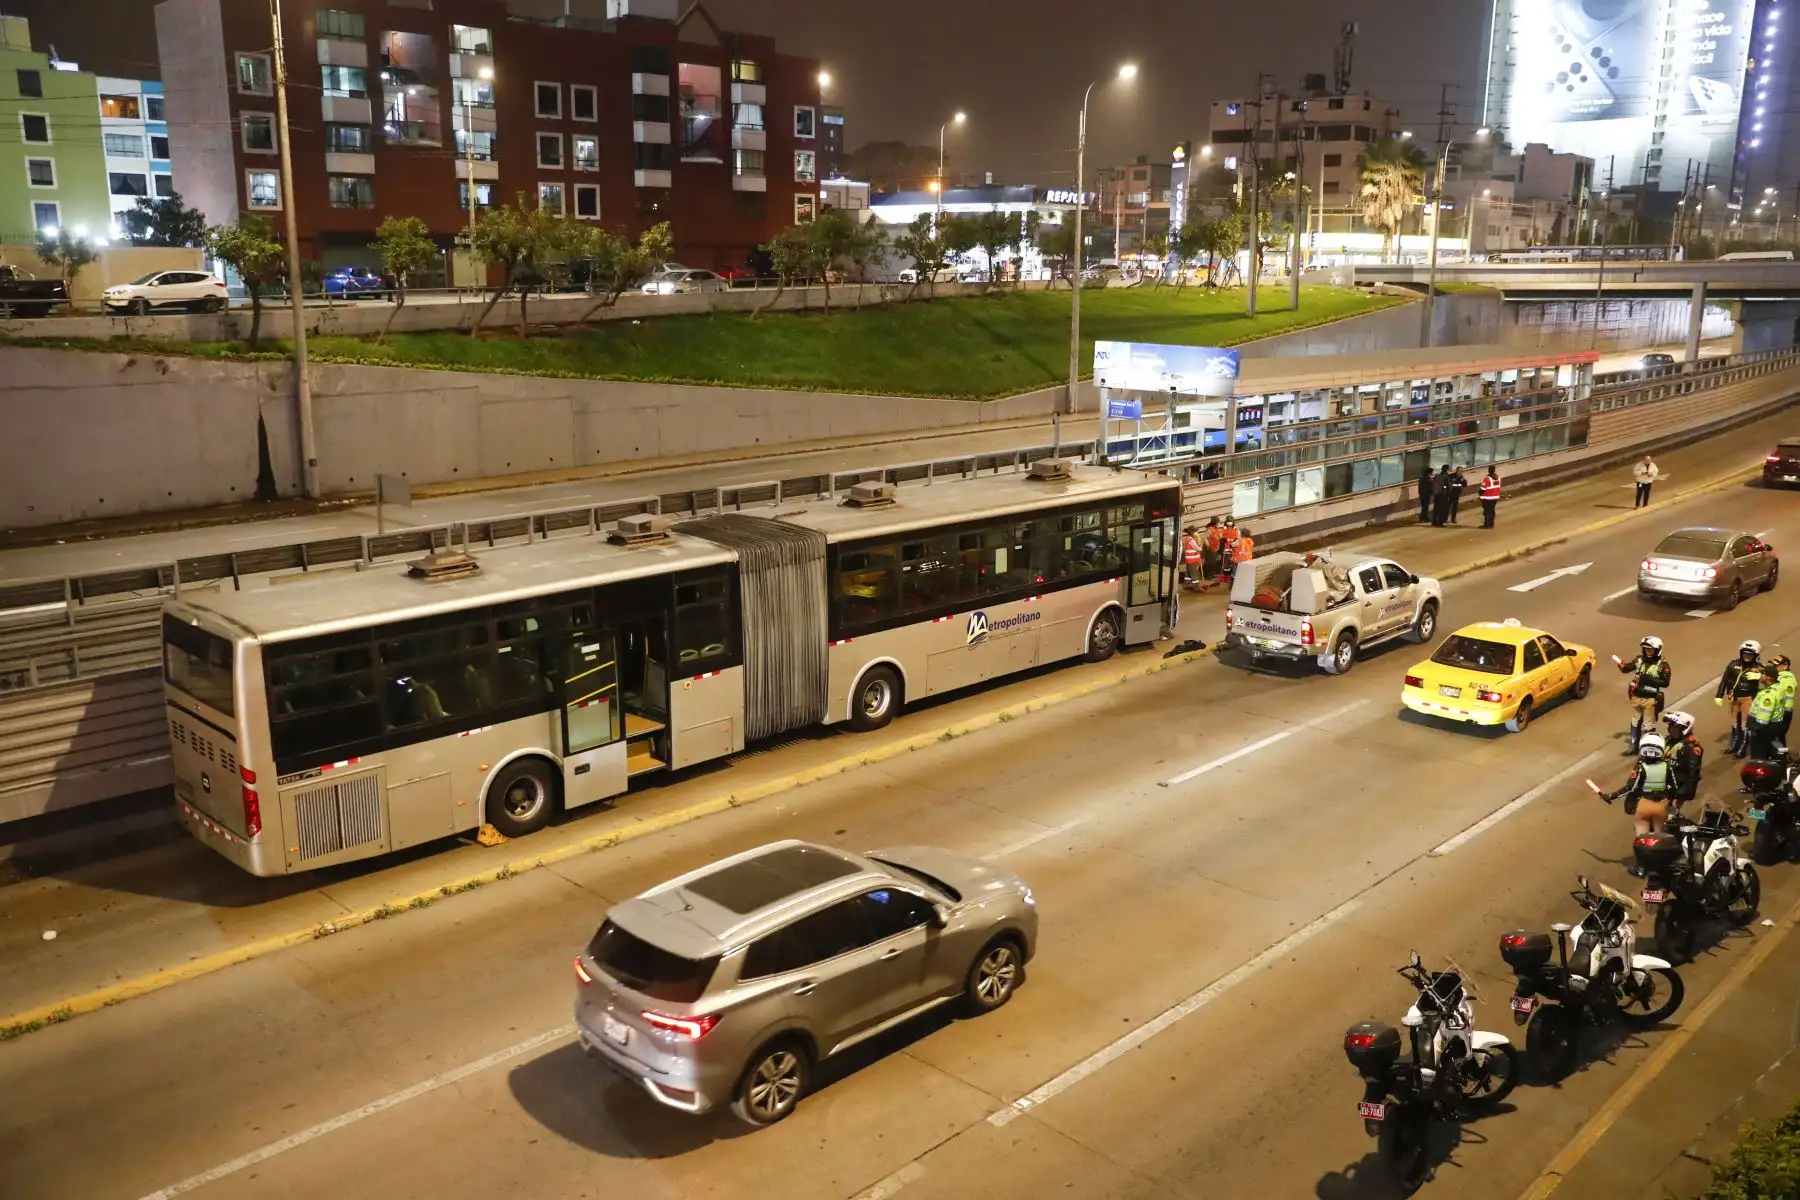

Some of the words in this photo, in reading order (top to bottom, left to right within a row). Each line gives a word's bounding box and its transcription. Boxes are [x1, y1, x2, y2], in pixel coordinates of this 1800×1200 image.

[967, 611, 1041, 645] Metropolitano
[1235, 617, 1298, 636] Metropolitano
[279, 774, 301, 784] TATSA
